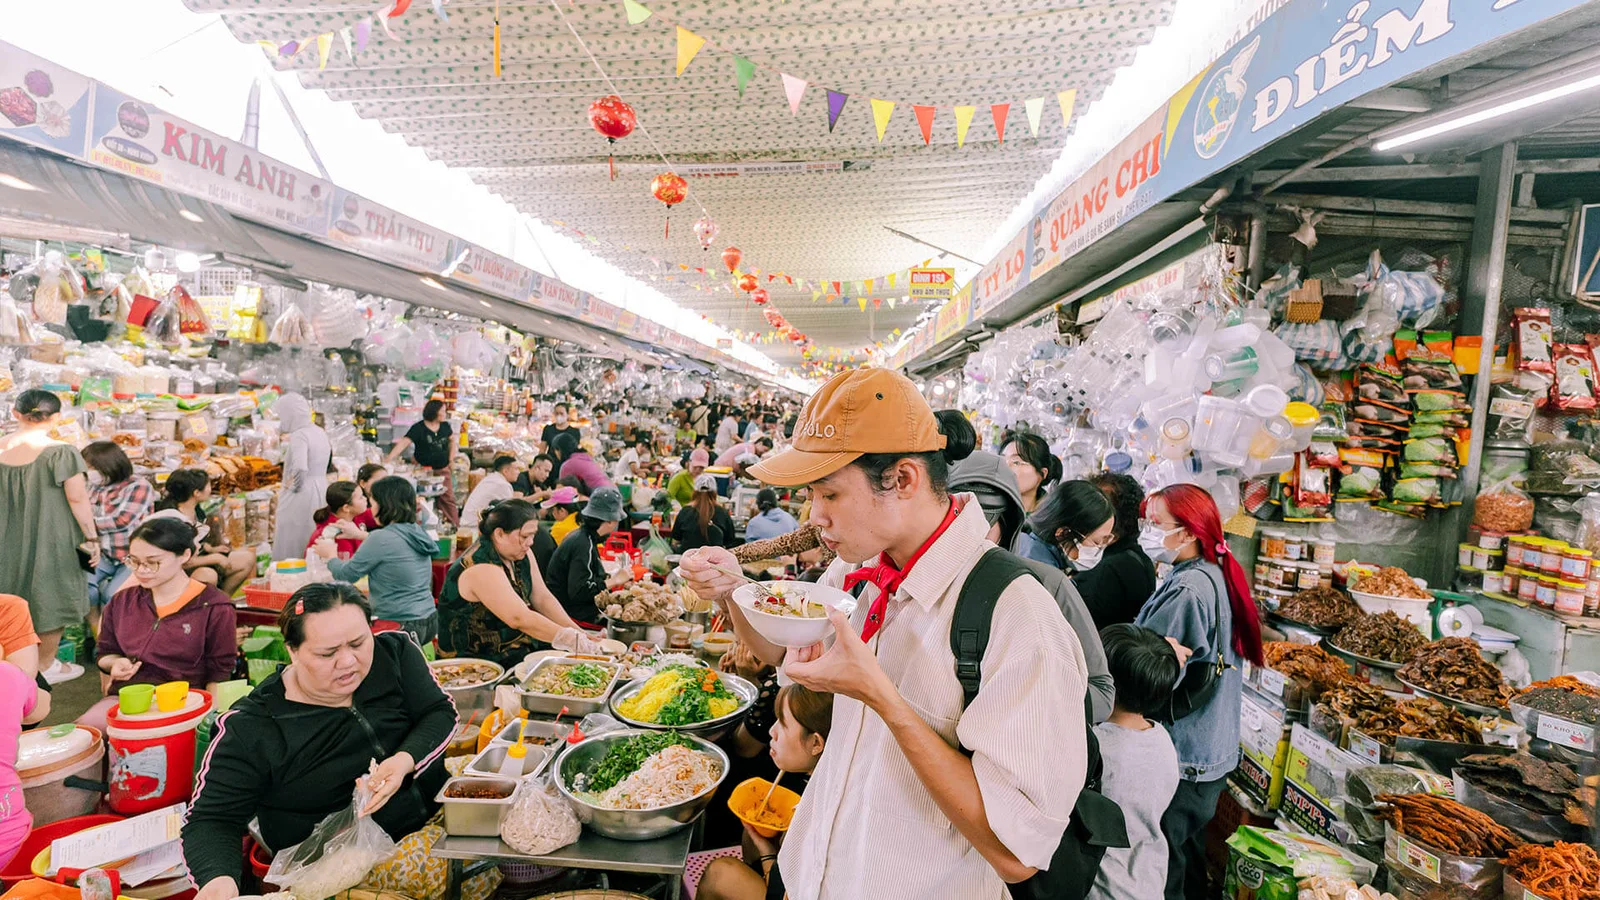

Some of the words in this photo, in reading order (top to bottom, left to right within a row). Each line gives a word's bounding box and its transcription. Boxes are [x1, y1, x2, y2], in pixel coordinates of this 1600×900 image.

[1251, 0, 1454, 134] ĐIỂM
[161, 121, 228, 176] KIM
[235, 155, 296, 201] ANH
[1049, 176, 1109, 253] QUANG
[1115, 132, 1163, 199] CHI
[1238, 864, 1261, 880] COCO
